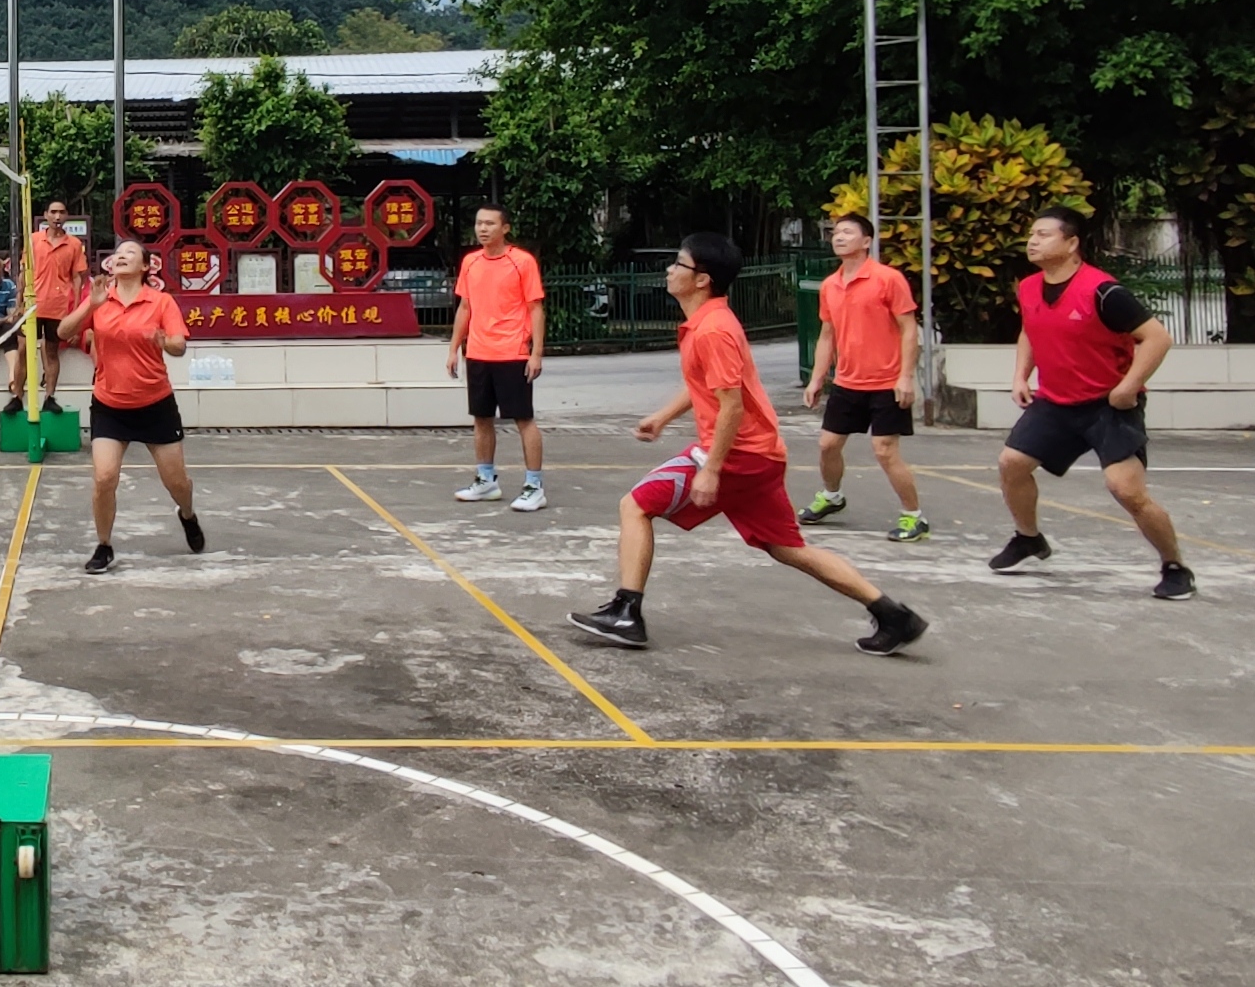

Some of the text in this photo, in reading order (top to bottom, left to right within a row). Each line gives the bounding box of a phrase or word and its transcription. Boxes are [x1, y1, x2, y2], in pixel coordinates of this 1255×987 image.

[133, 205, 161, 216] 忠诚
[226, 203, 254, 214] 公道
[293, 203, 320, 214] 实事
[386, 202, 414, 213] 清正
[133, 216, 161, 227] 老实
[227, 215, 255, 226] 正派
[293, 214, 320, 226] 求是
[181, 251, 208, 262] 光明
[340, 249, 368, 260] 艰苦
[181, 262, 208, 273] 坦荡
[341, 261, 368, 272] 奋斗
[186, 306, 382, 327] 共产党员核心价值观
